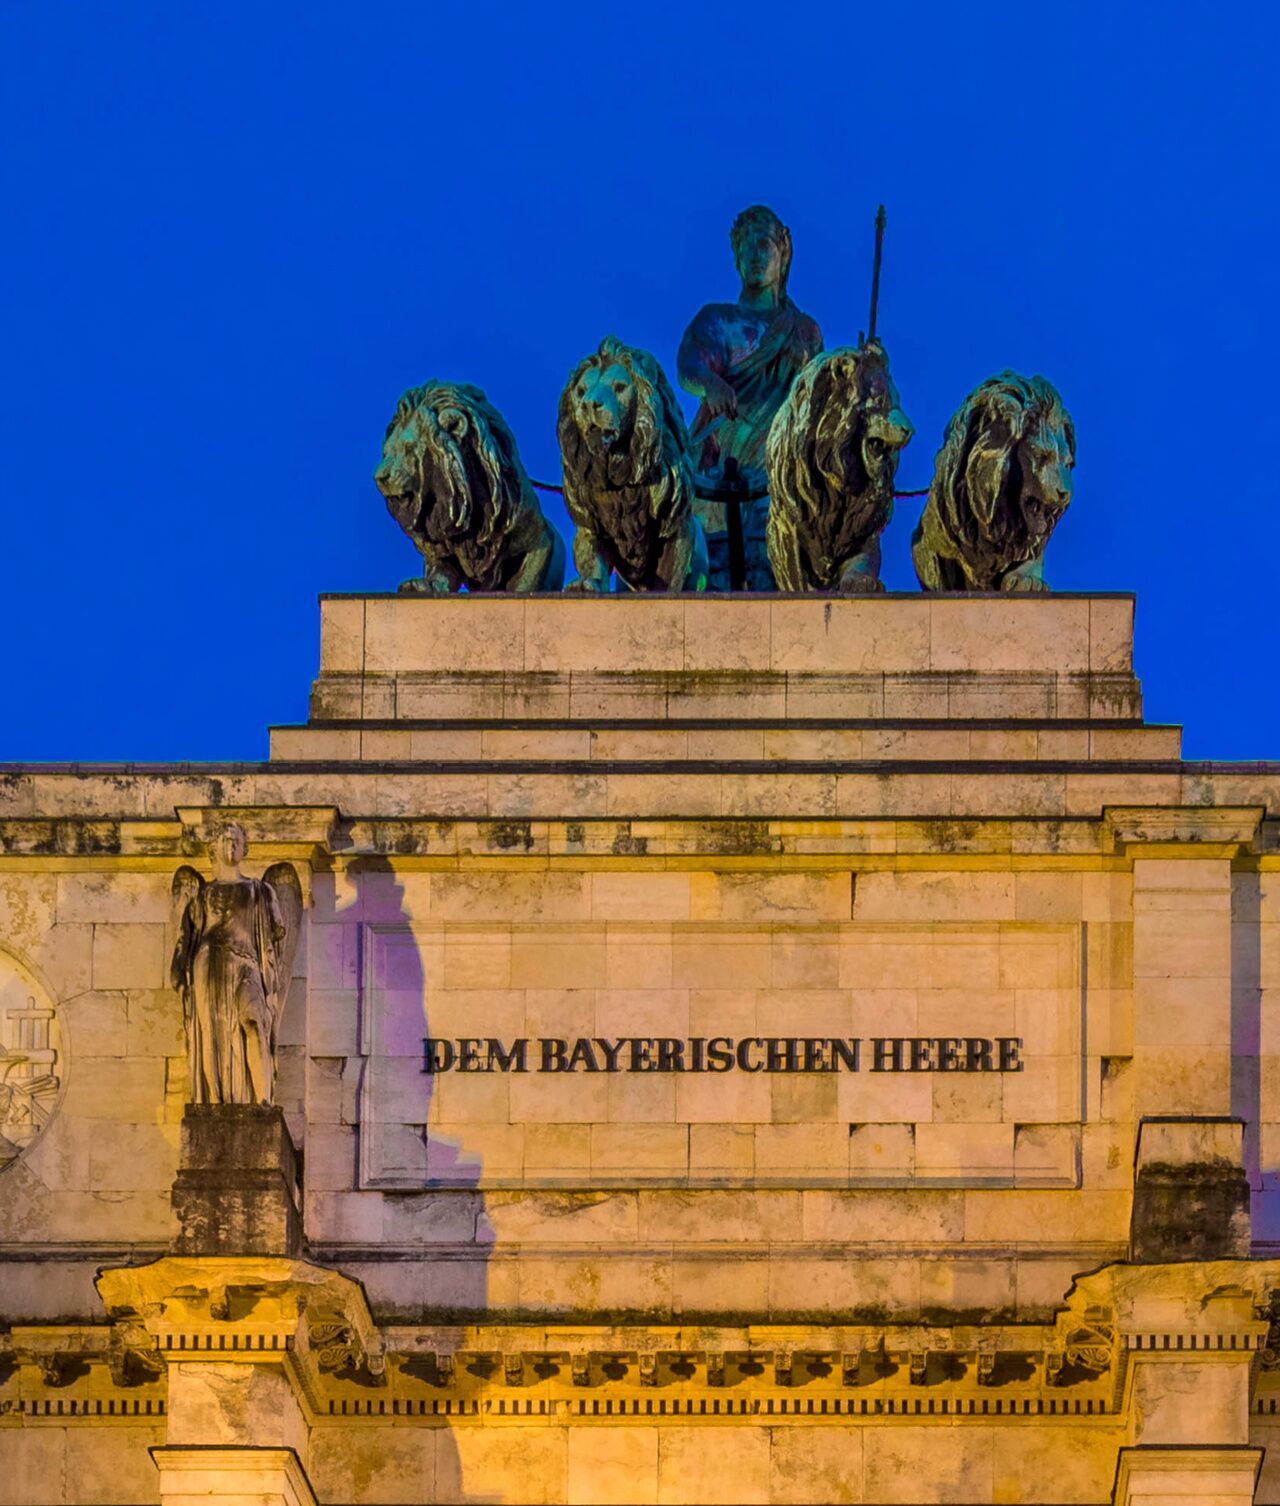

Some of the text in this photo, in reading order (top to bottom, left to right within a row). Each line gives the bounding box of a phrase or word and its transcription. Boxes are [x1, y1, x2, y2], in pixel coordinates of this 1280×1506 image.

[421, 1036, 1024, 1073] DEM BAYERISCHEN HEERE
